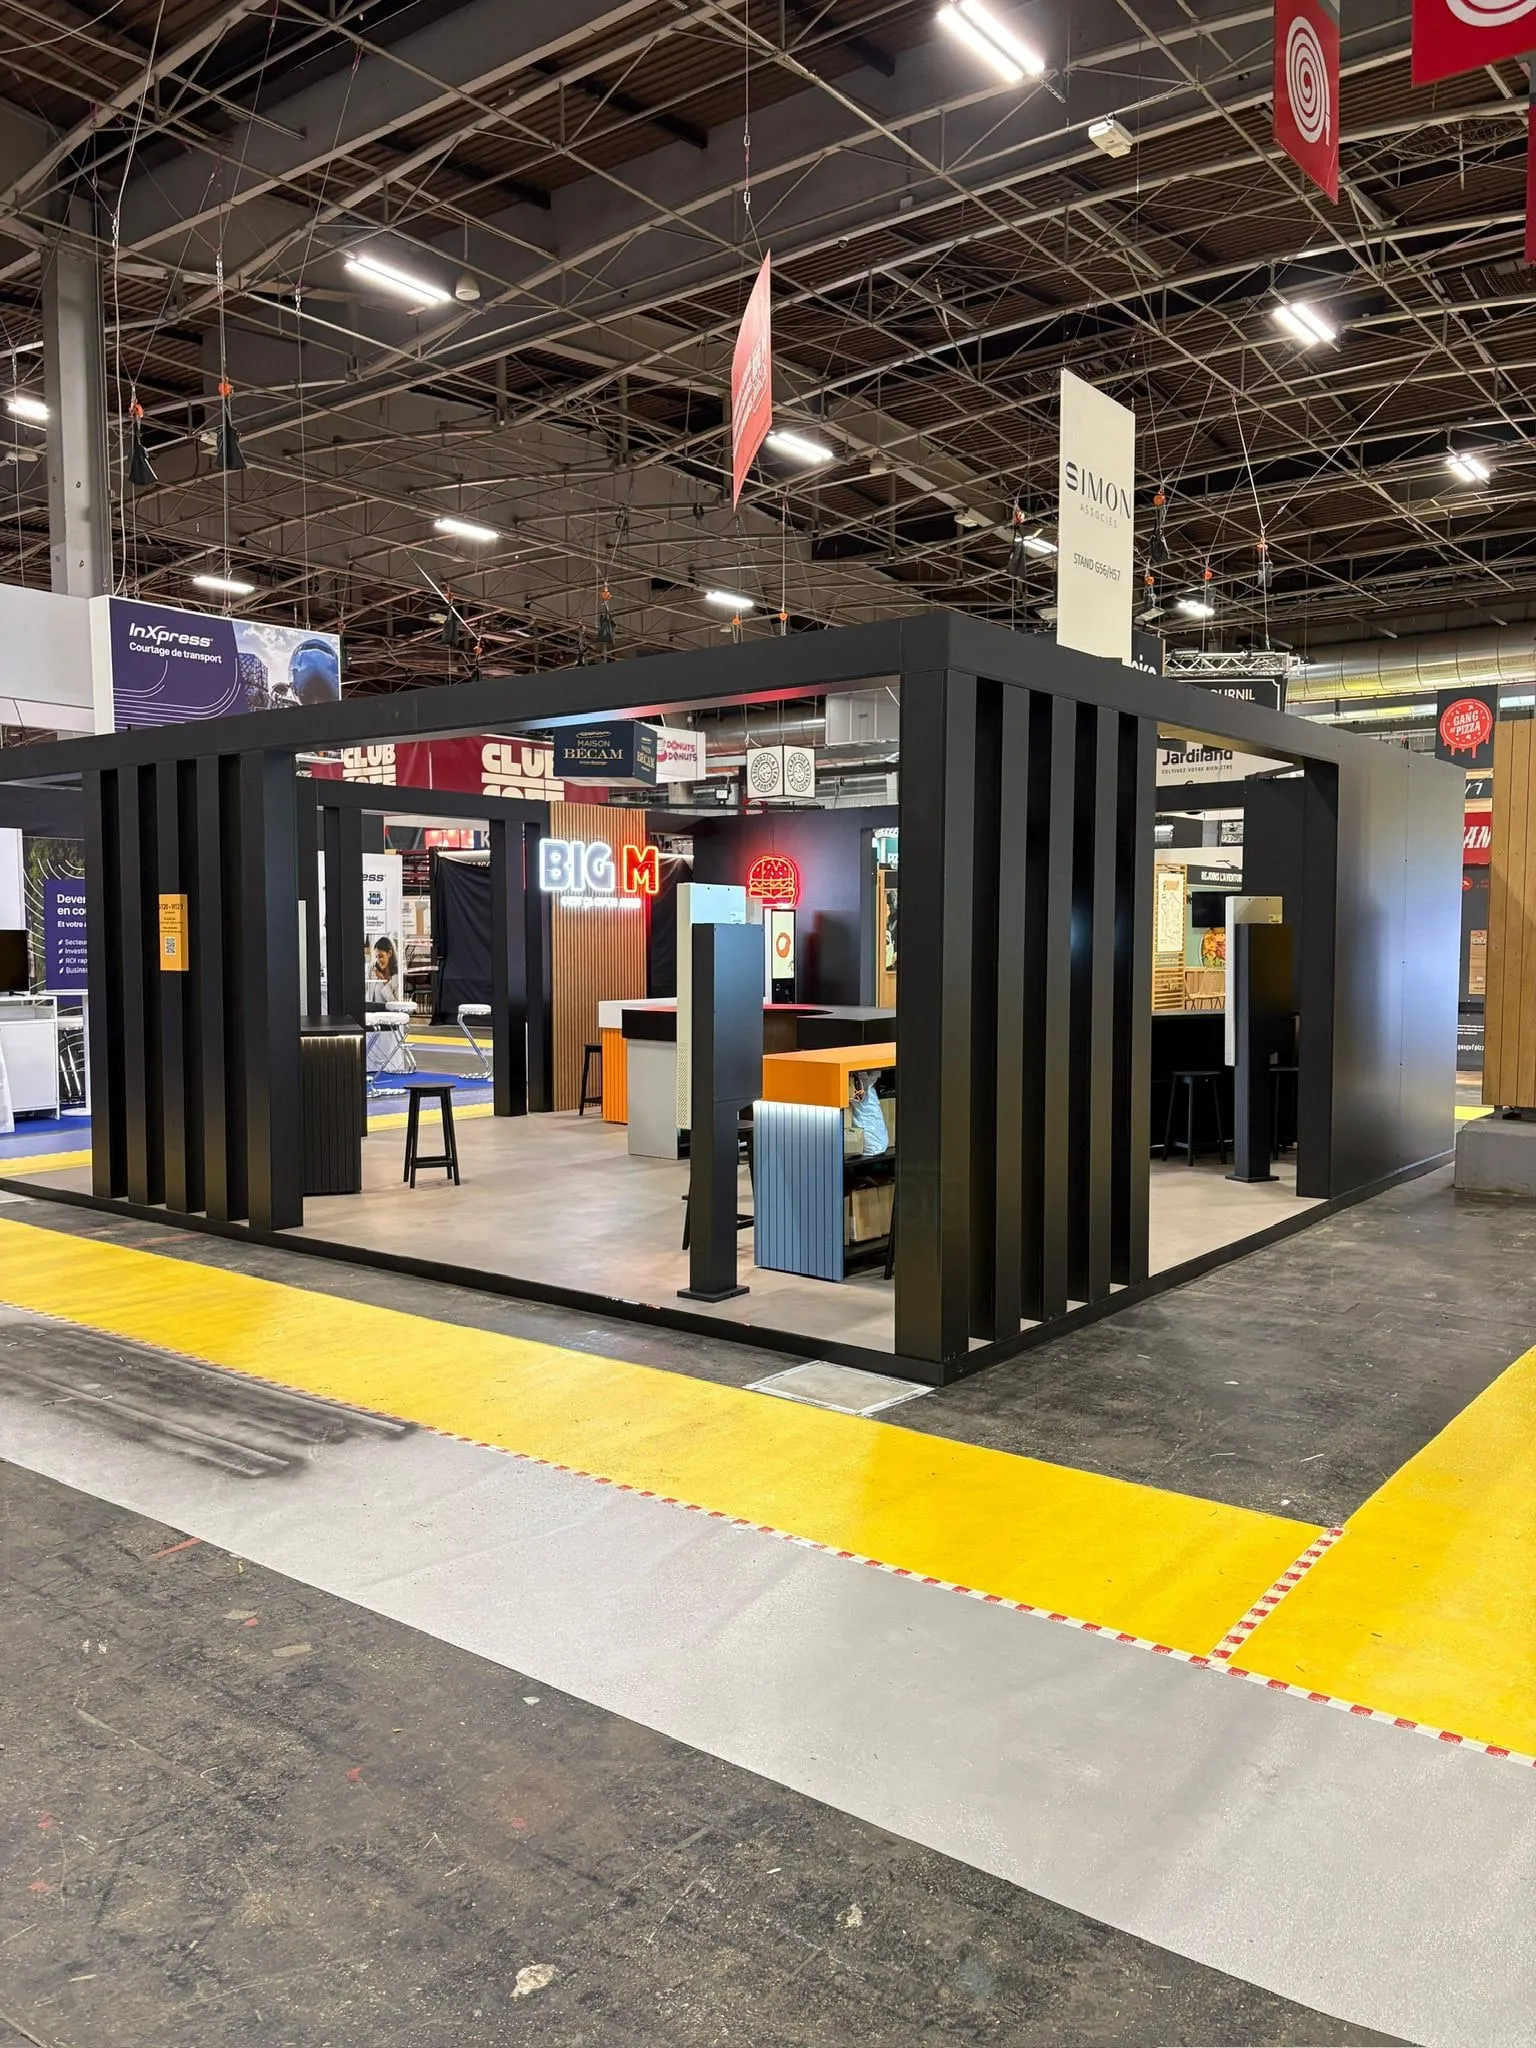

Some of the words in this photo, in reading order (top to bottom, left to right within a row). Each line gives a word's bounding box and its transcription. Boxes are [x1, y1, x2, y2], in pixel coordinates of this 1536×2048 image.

[1065, 461, 1132, 520] SIMON
[1073, 553, 1094, 571] STAND
[129, 623, 212, 648] InXpress
[129, 642, 171, 657] Courtage
[171, 648, 182, 658] de
[183, 650, 222, 664] transport
[1453, 710, 1479, 726] GANG
[1455, 721, 1481, 736] PIZZA
[577, 740, 610, 748] MAISON
[667, 740, 696, 752] DONUTS
[342, 743, 396, 769] CLUB
[668, 752, 697, 762] DONUTS
[1162, 749, 1233, 766] Jardiland
[539, 838, 615, 892] BIG
[623, 845, 659, 894] M
[57, 907, 70, 915] en
